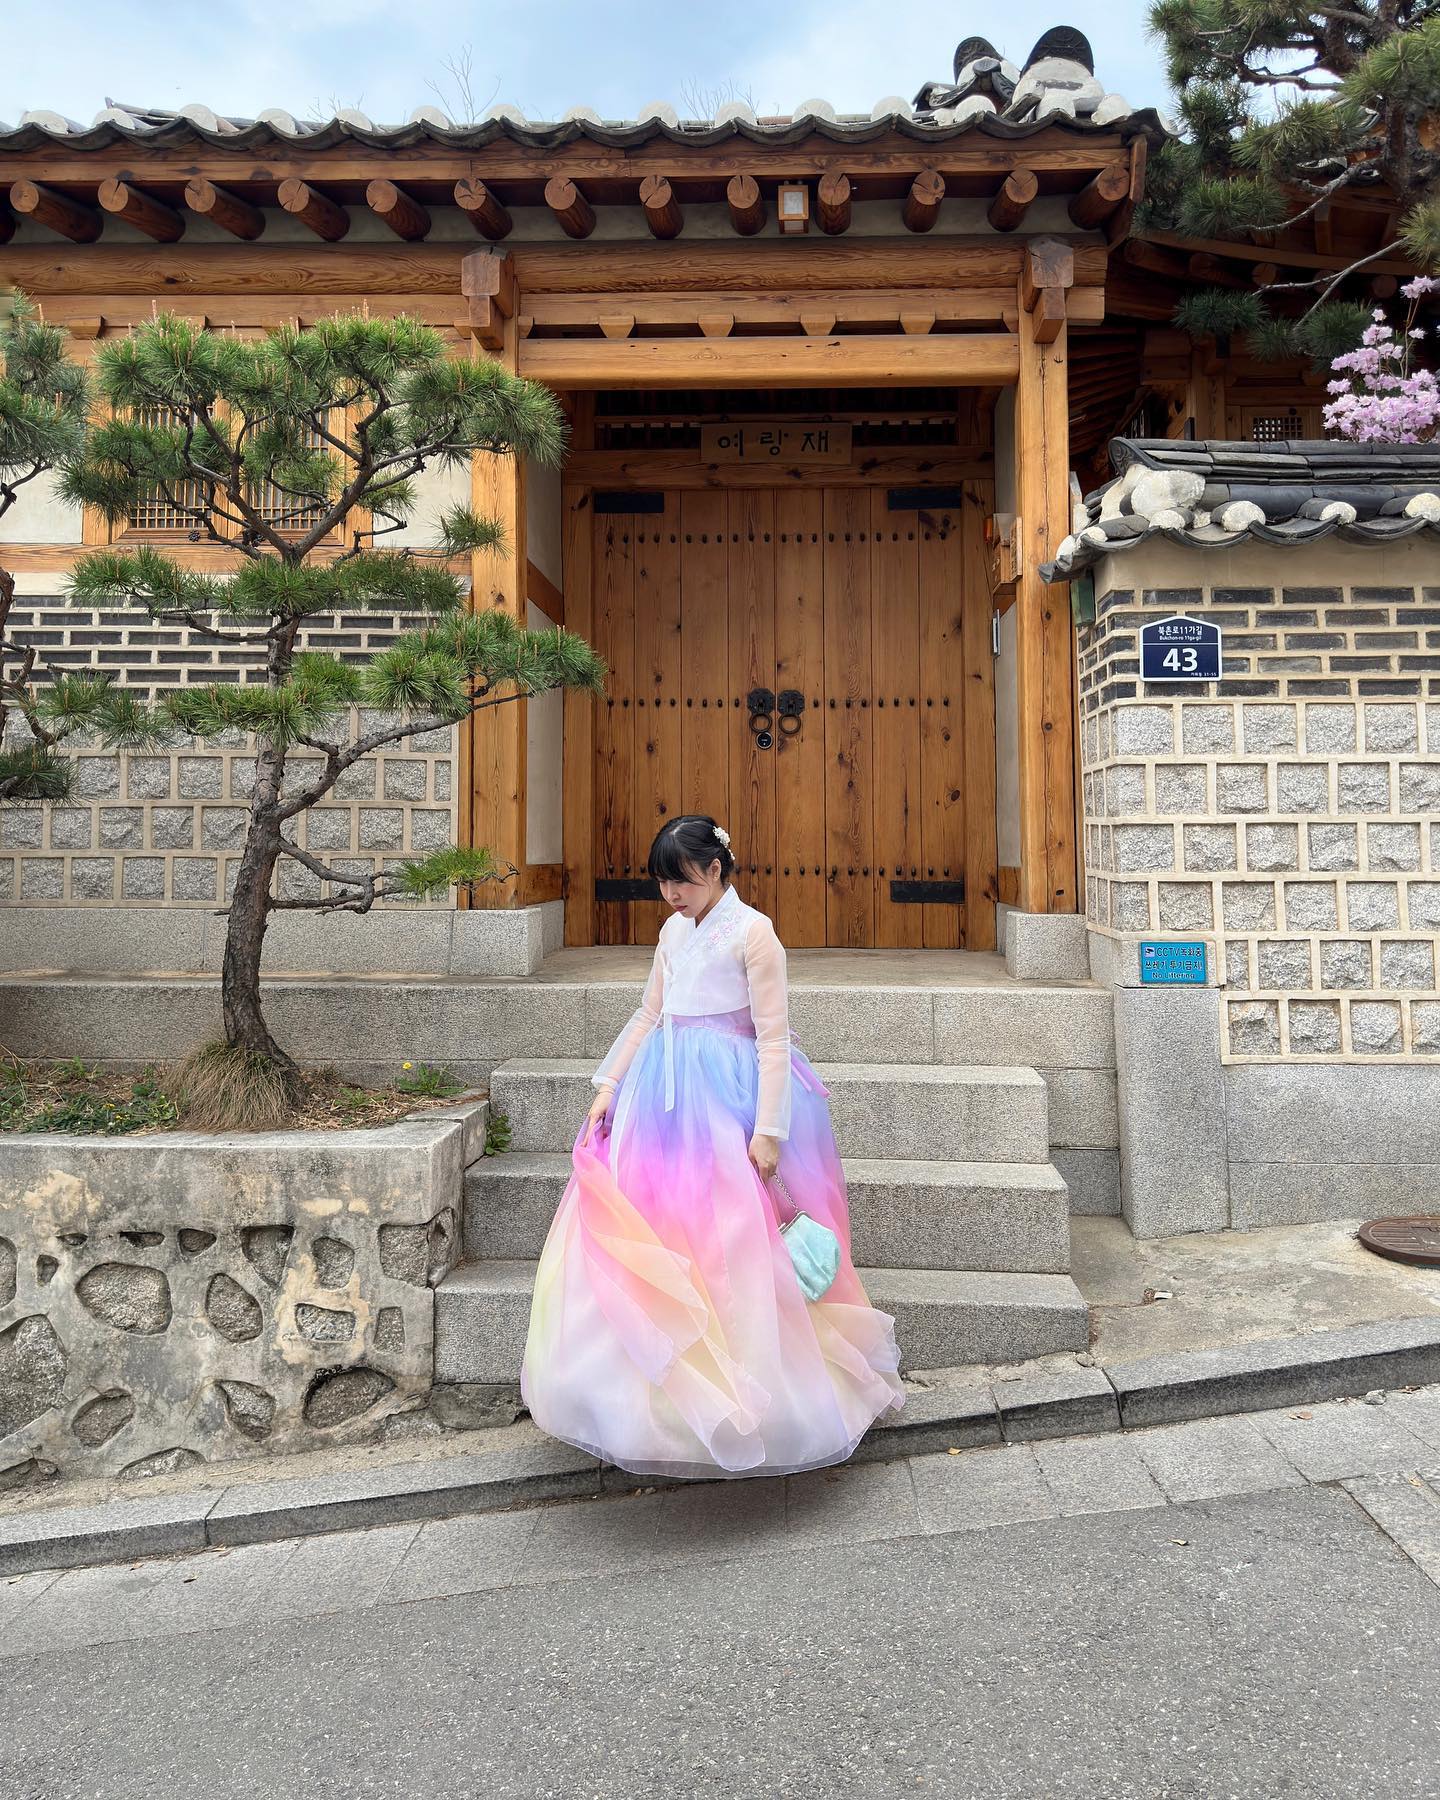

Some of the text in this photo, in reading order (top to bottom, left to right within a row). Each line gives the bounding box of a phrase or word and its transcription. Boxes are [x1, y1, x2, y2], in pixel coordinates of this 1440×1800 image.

[1158, 626, 1203, 636] 북촌로11가길
[1162, 648, 1198, 672] 43
[1164, 972, 1195, 980] Littering
